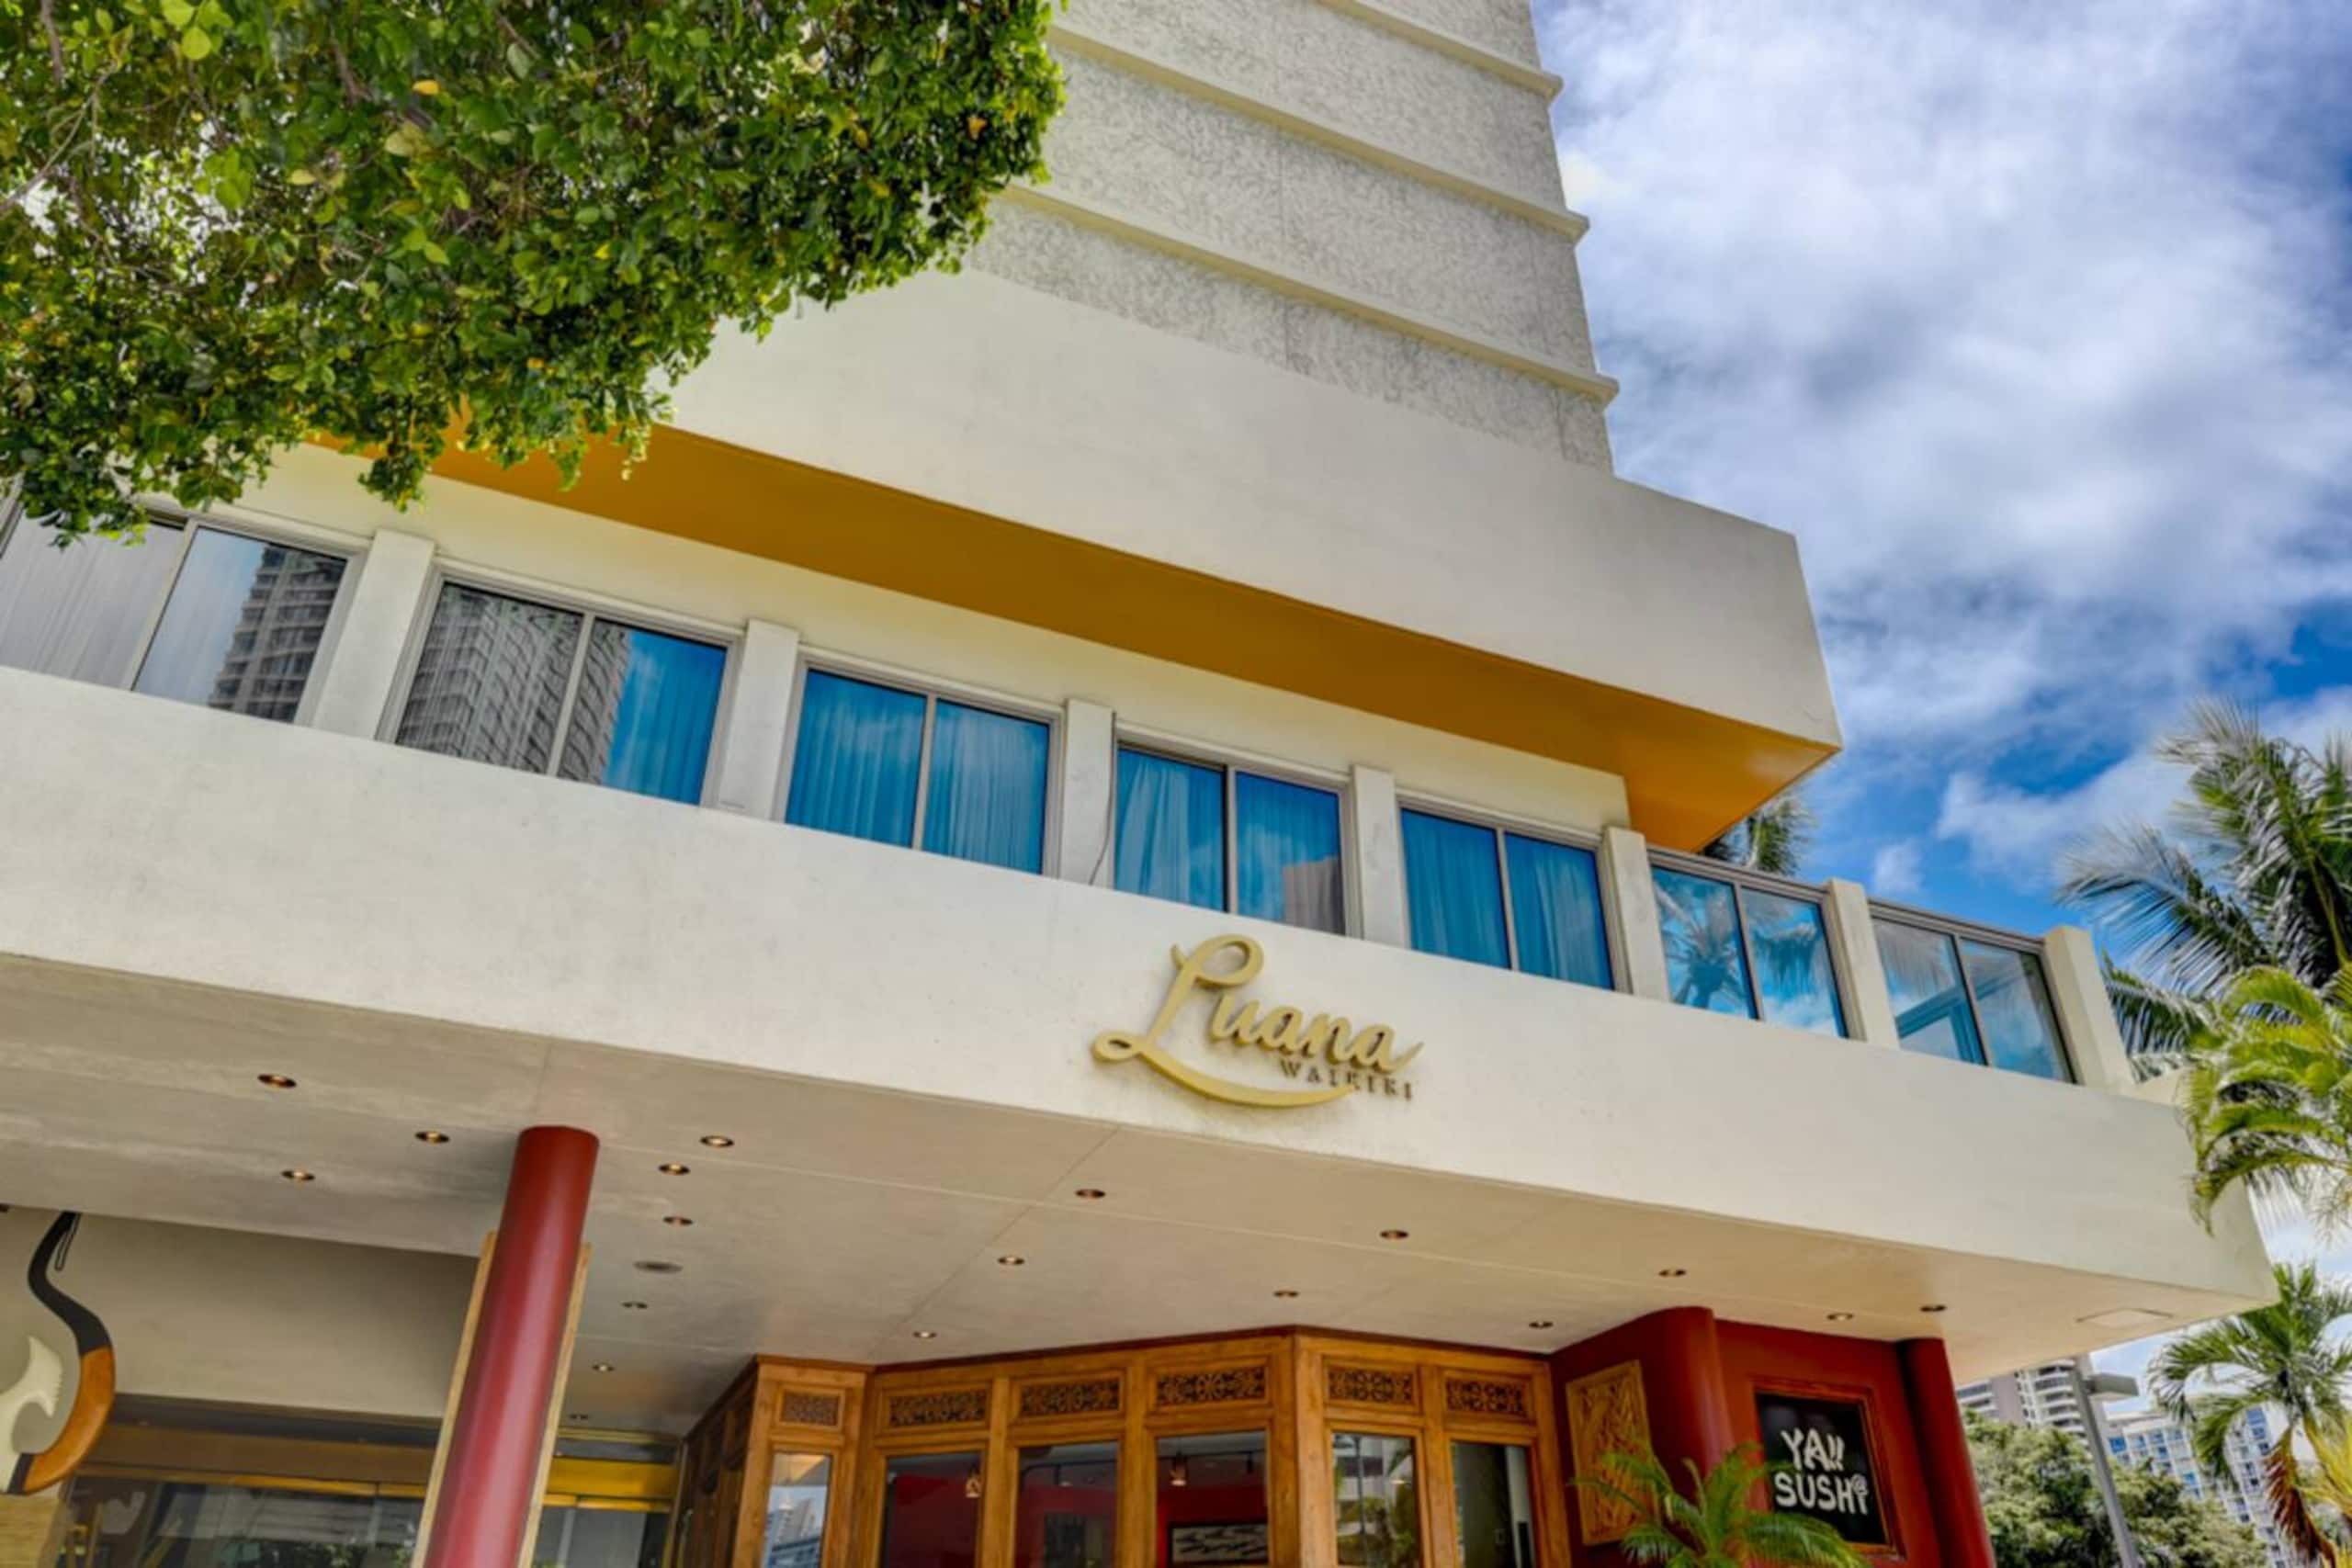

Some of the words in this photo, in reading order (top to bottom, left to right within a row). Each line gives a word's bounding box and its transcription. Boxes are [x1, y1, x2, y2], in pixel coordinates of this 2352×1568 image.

[1091, 933, 1424, 1108] Luana
[1279, 1059, 1412, 1100] WAIKIKI
[1781, 1427, 1845, 1472] YA!!
[1774, 1472, 1869, 1515] SUSHI
